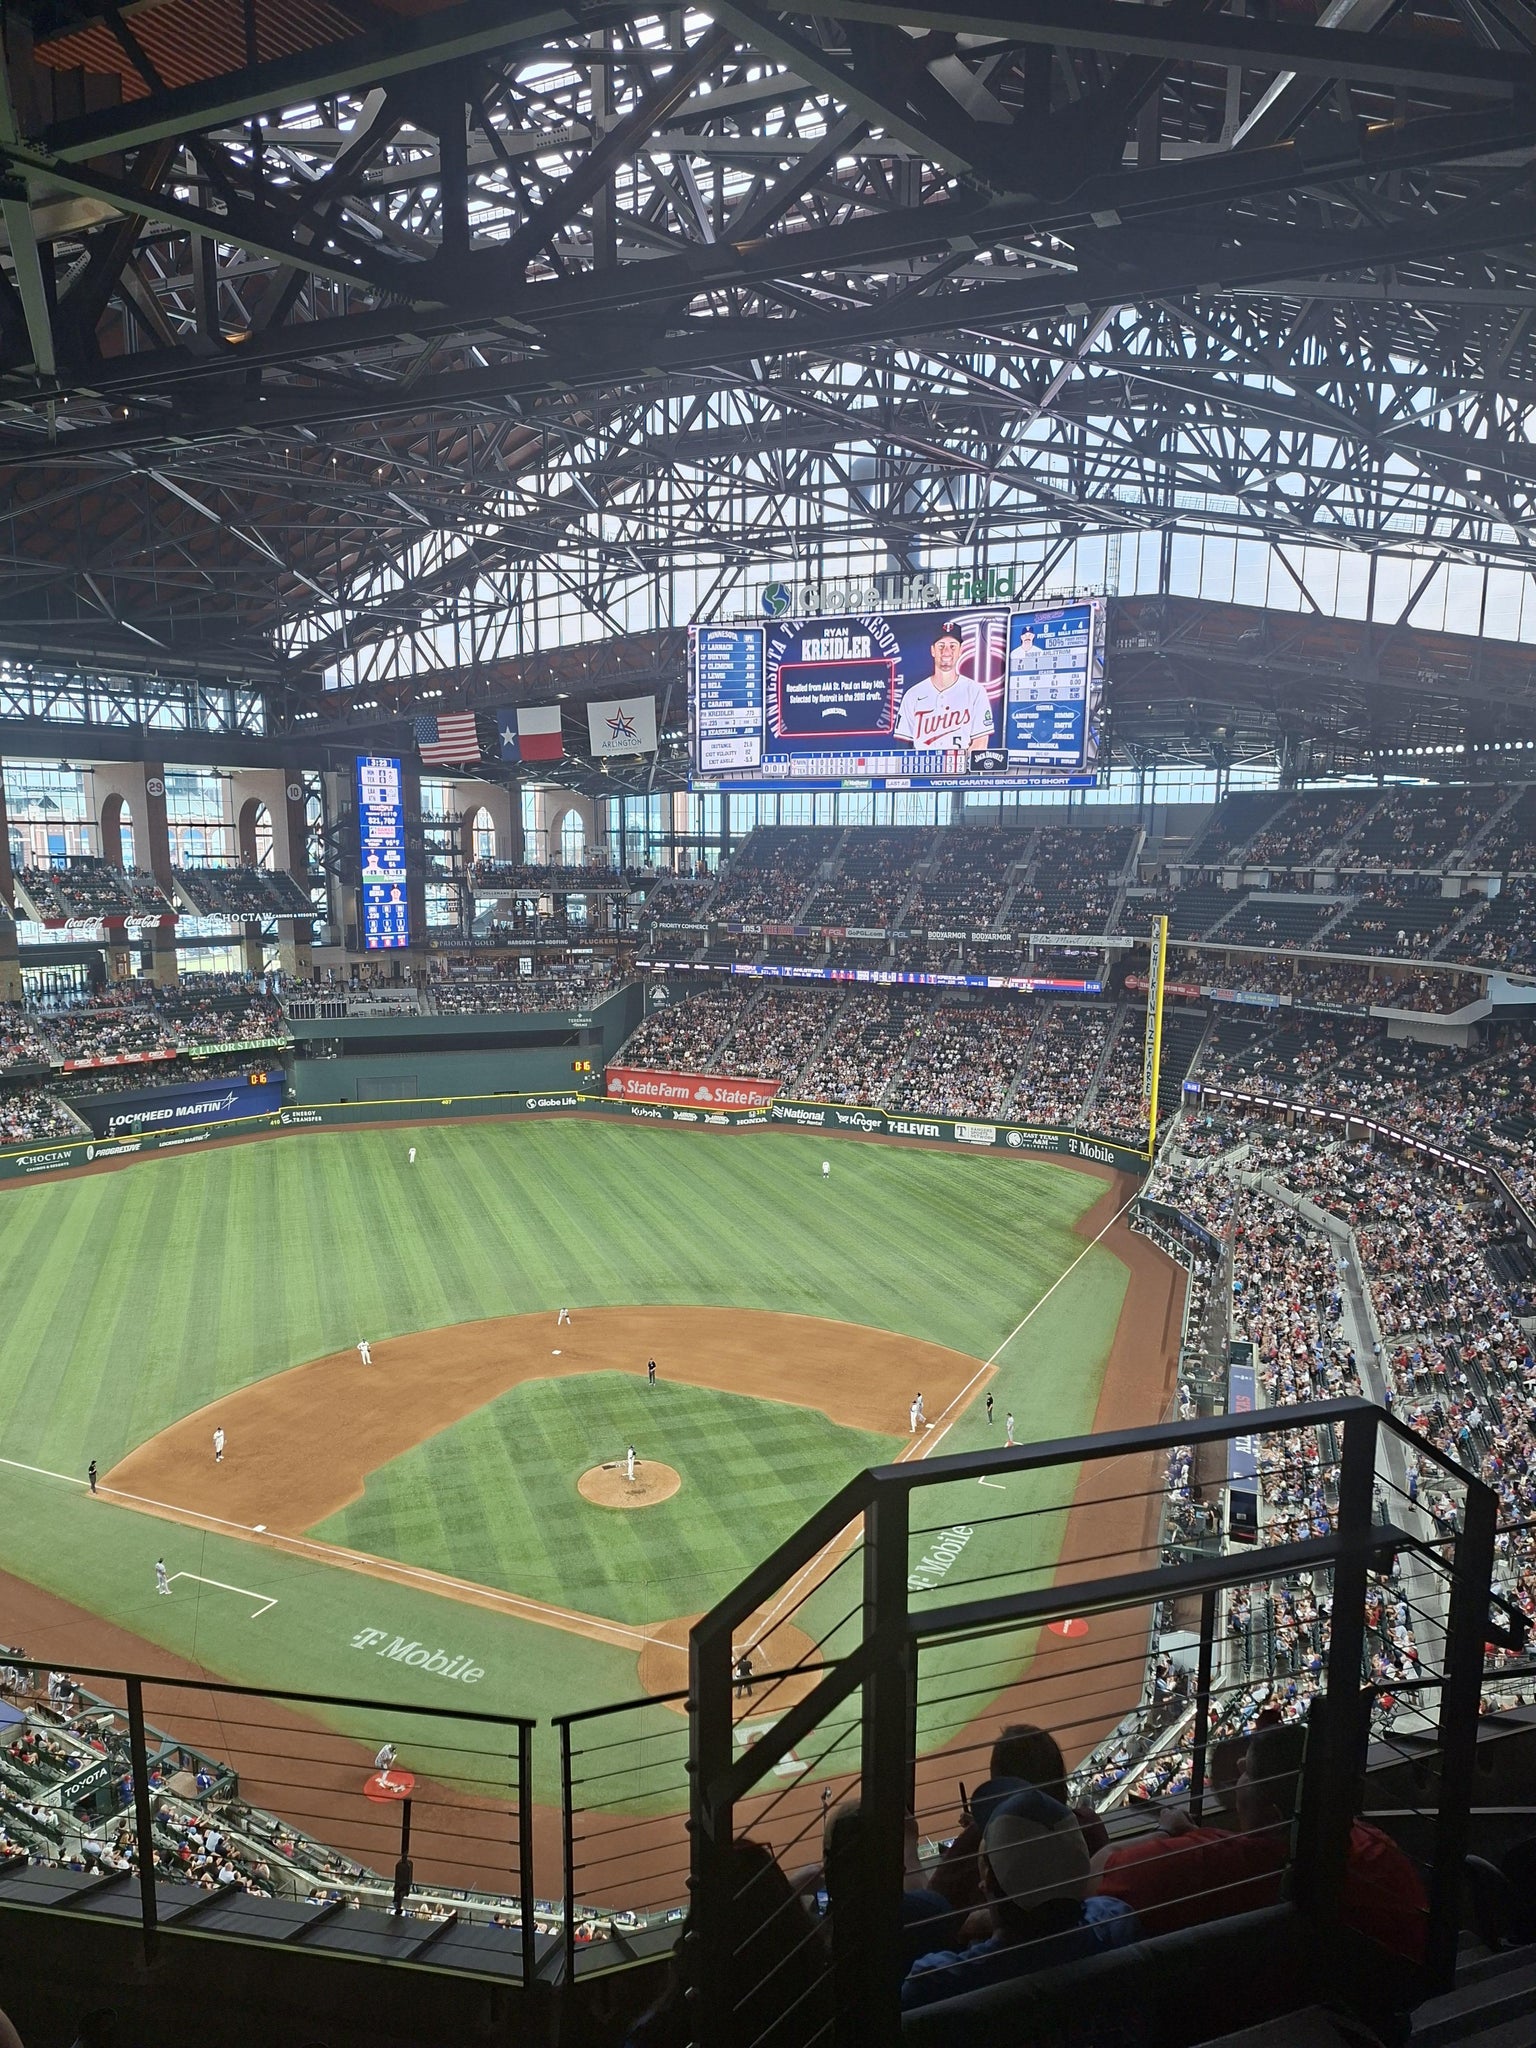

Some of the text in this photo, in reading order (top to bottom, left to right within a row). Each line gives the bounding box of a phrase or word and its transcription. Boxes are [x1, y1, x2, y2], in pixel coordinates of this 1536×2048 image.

[799, 567, 1015, 612] Globe Life Field
[824, 627, 849, 638] RYAN
[801, 636, 871, 661] KREIDLER
[786, 684, 808, 693] Recalled
[808, 683, 821, 692] from
[822, 682, 833, 691] AAA
[841, 681, 853, 690] Paul
[861, 680, 872, 690] May
[789, 695, 811, 704] Selected
[811, 695, 818, 704] by
[819, 693, 837, 703] Detroit
[707, 710, 735, 718] KREIDLER
[914, 706, 971, 740] Twins
[601, 739, 642, 749] ARLINGTON
[952, 736, 961, 748] 5
[149, 781, 162, 793] 29
[290, 788, 299, 797] 10
[213, 912, 273, 922] CHOCTAW
[659, 922, 681, 930] PRIORITY
[742, 925, 762, 933] 105.3
[847, 930, 884, 938] GoPGL.com
[892, 931, 908, 939] PGL
[927, 931, 1012, 941] BODYARMOR BODYARMOR
[1031, 934, 1051, 944] Blue
[199, 1037, 287, 1054] LUXOR STAFFING
[73, 1050, 166, 1067] DEX DEX DEX DEX
[1145, 1047, 1153, 1093] FARE
[537, 1098, 561, 1107] Globe
[561, 1097, 577, 1106] Life
[108, 1101, 222, 1127] LOCKHEED MARTIN
[631, 1106, 663, 1119] Kubota
[783, 1107, 824, 1122] National
[736, 1117, 768, 1126] HONDA
[850, 1111, 882, 1132] Kroger
[158, 1135, 204, 1148] LOCKHEED MARTIN
[1023, 1132, 1060, 1142] EAST TEXAS
[1032, 1138, 1049, 1146] A&M
[94, 1143, 142, 1158] PROGRESSIVE
[1079, 1141, 1115, 1164] Mobile
[21, 1150, 72, 1165] CHOCTAW
[921, 1524, 975, 1578] Mobile
[376, 1635, 486, 1684] Mobile
[64, 1767, 108, 1797] TOYOTA
